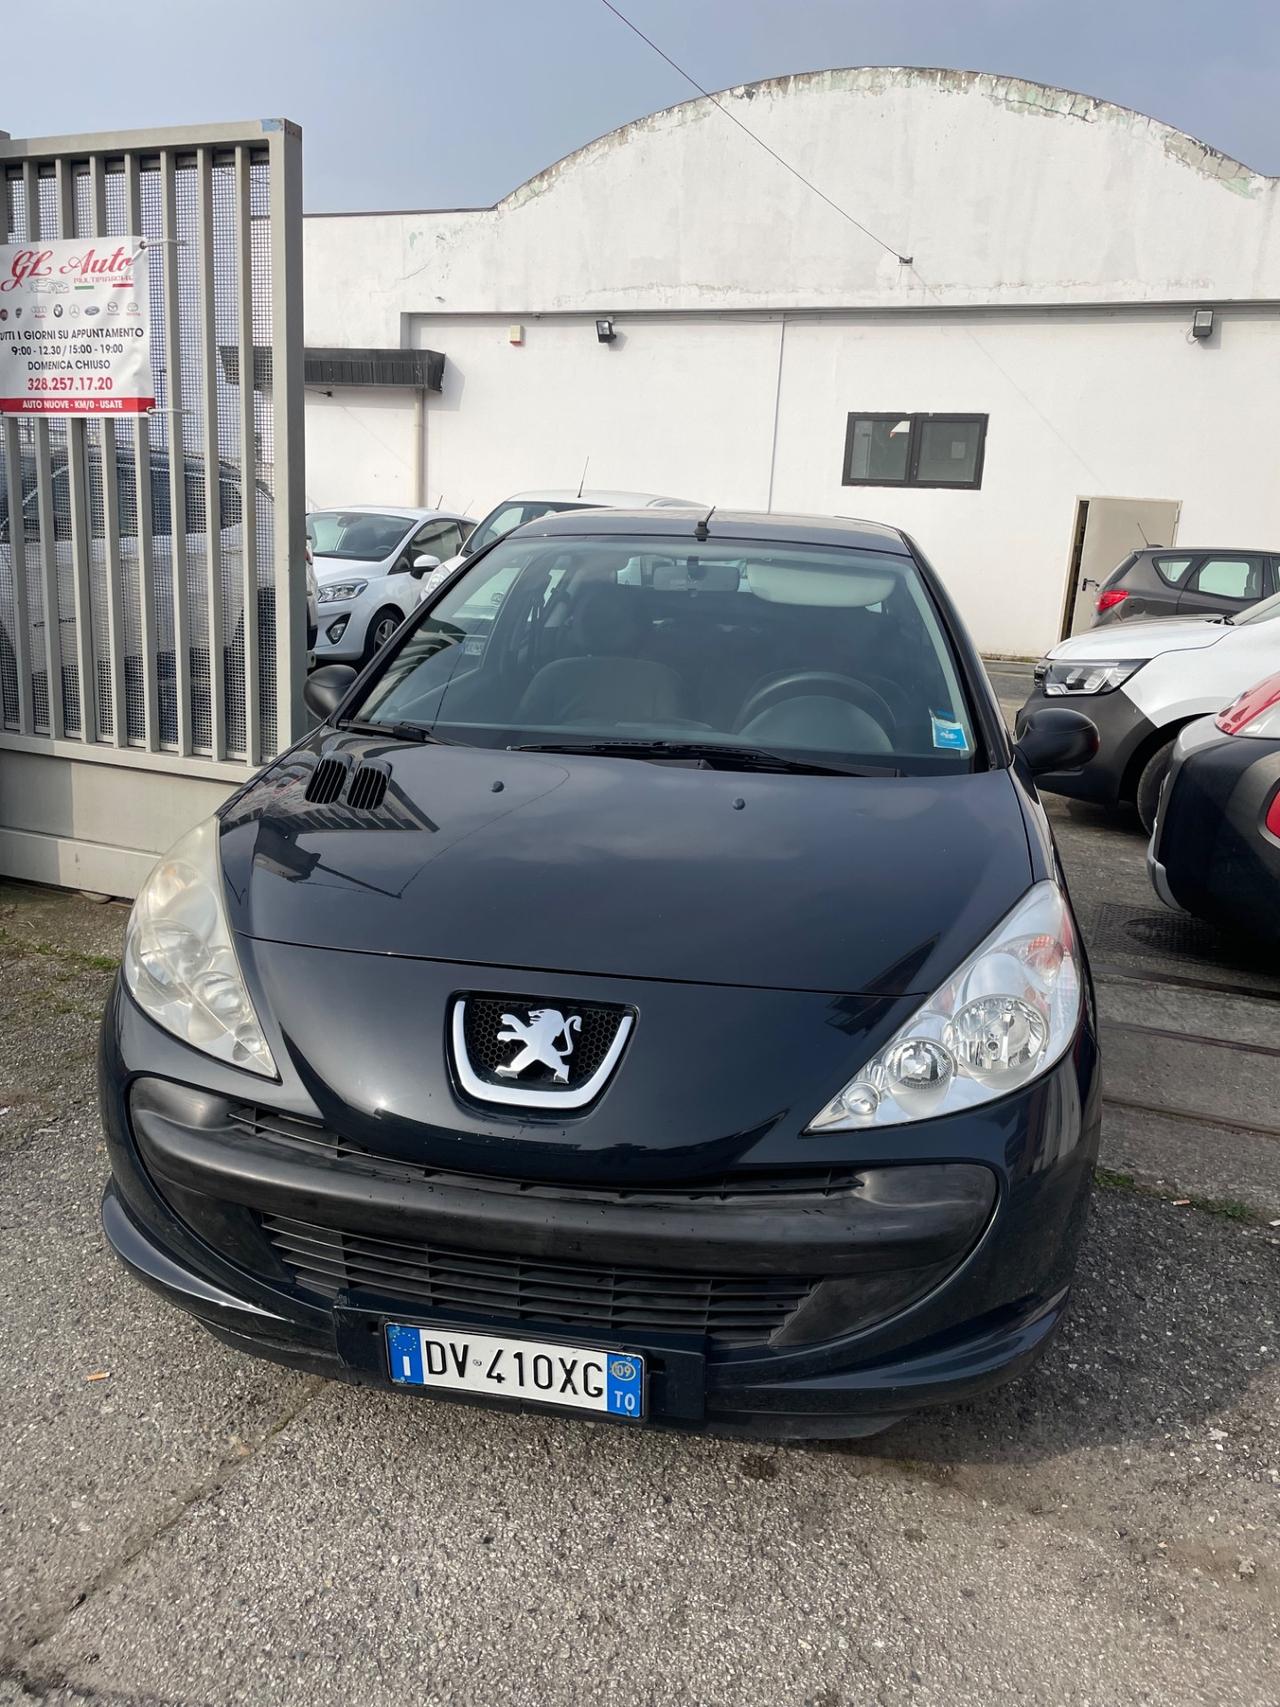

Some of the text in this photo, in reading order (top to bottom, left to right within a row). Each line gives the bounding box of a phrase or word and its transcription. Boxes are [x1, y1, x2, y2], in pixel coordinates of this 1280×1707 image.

[59, 246, 134, 276] Auto
[0, 328, 144, 341] UTTI I GIORNI SU APPUNTAMENTO
[11, 346, 32, 355] 9:00
[39, 346, 61, 355] 12.30
[69, 344, 92, 354] 15:00
[100, 343, 124, 354] 19:00
[28, 359, 111, 371] DOMENICA CHIUSO
[27, 377, 113, 391] 328.257.17.20
[22, 400, 43, 409] AUTO
[44, 400, 69, 409] NUOVE
[75, 400, 95, 410] KM/0
[100, 400, 123, 409] USATE
[425, 1340, 604, 1398] DV 410XG
[615, 1364, 632, 1377] 09
[613, 1390, 636, 1411] TO
